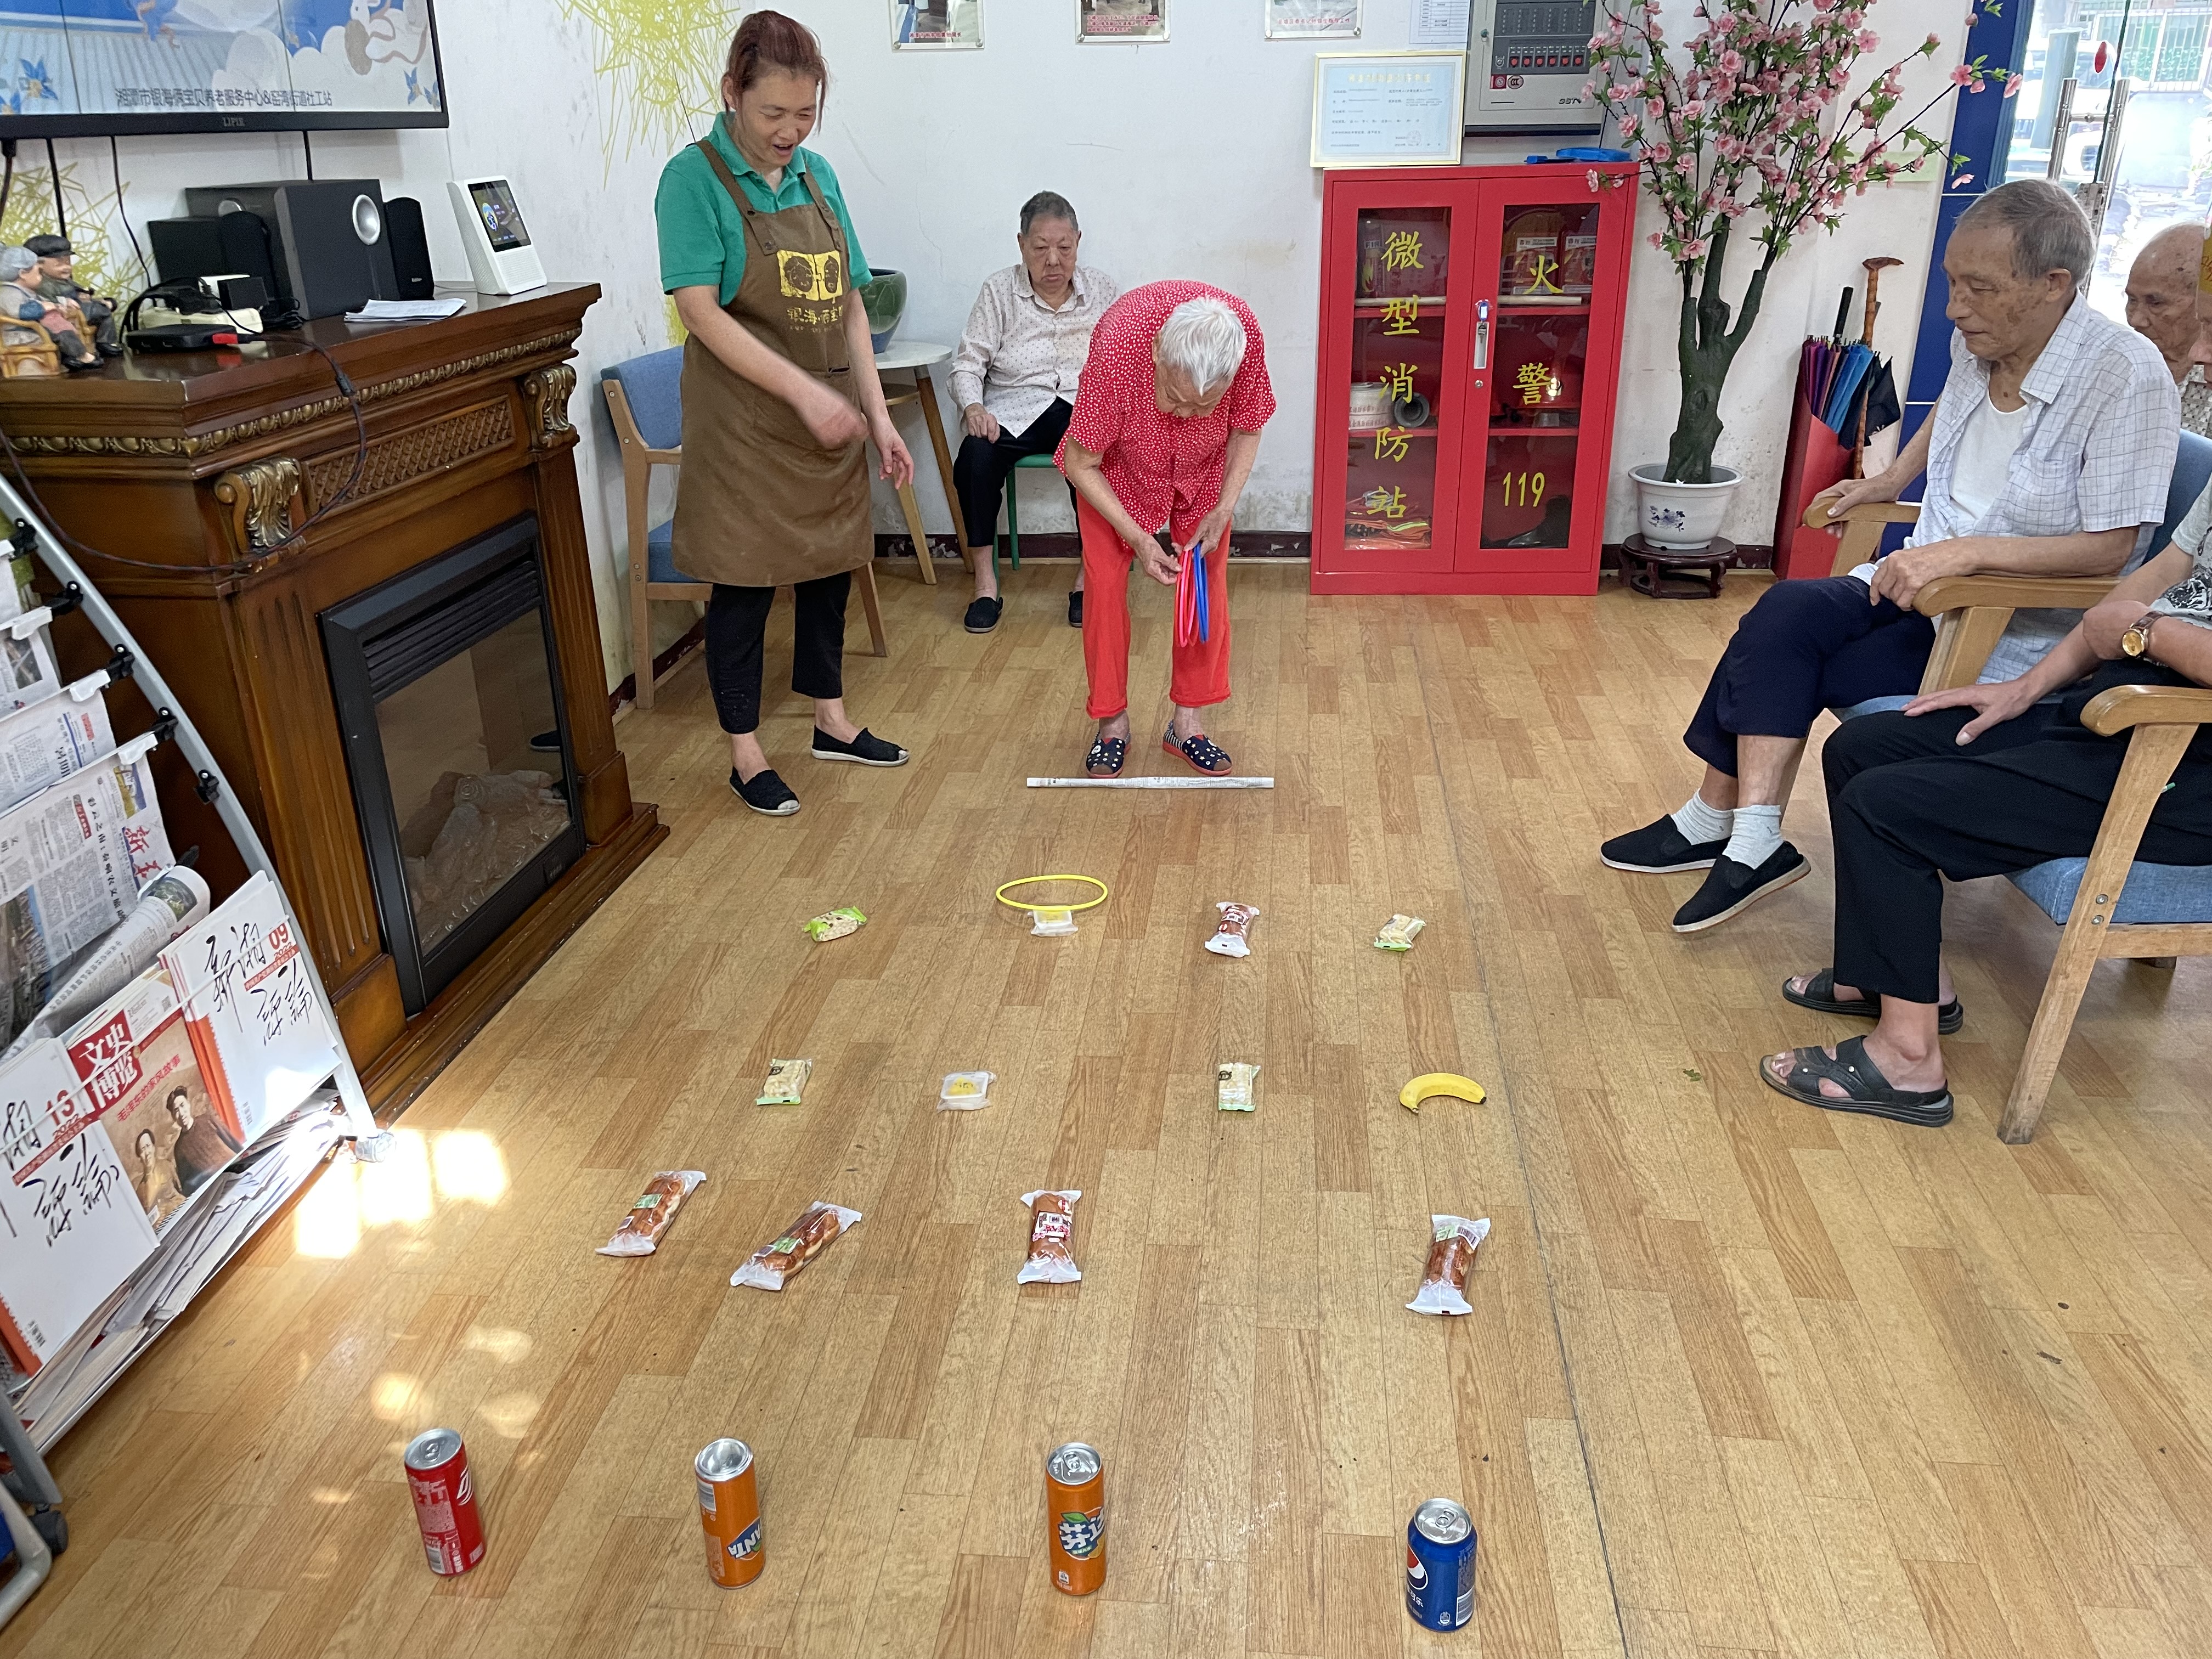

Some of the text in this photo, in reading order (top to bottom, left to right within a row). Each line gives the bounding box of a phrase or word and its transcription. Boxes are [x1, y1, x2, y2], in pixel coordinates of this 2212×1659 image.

[1513, 255, 1563, 405] 火警
[1367, 231, 1424, 518] 微型消防站
[1503, 472, 1545, 507] 119
[269, 922, 289, 950] 09
[274, 941, 294, 961] 2022
[78, 1023, 133, 1080] 文史
[728, 1523, 760, 1559] ANTA
